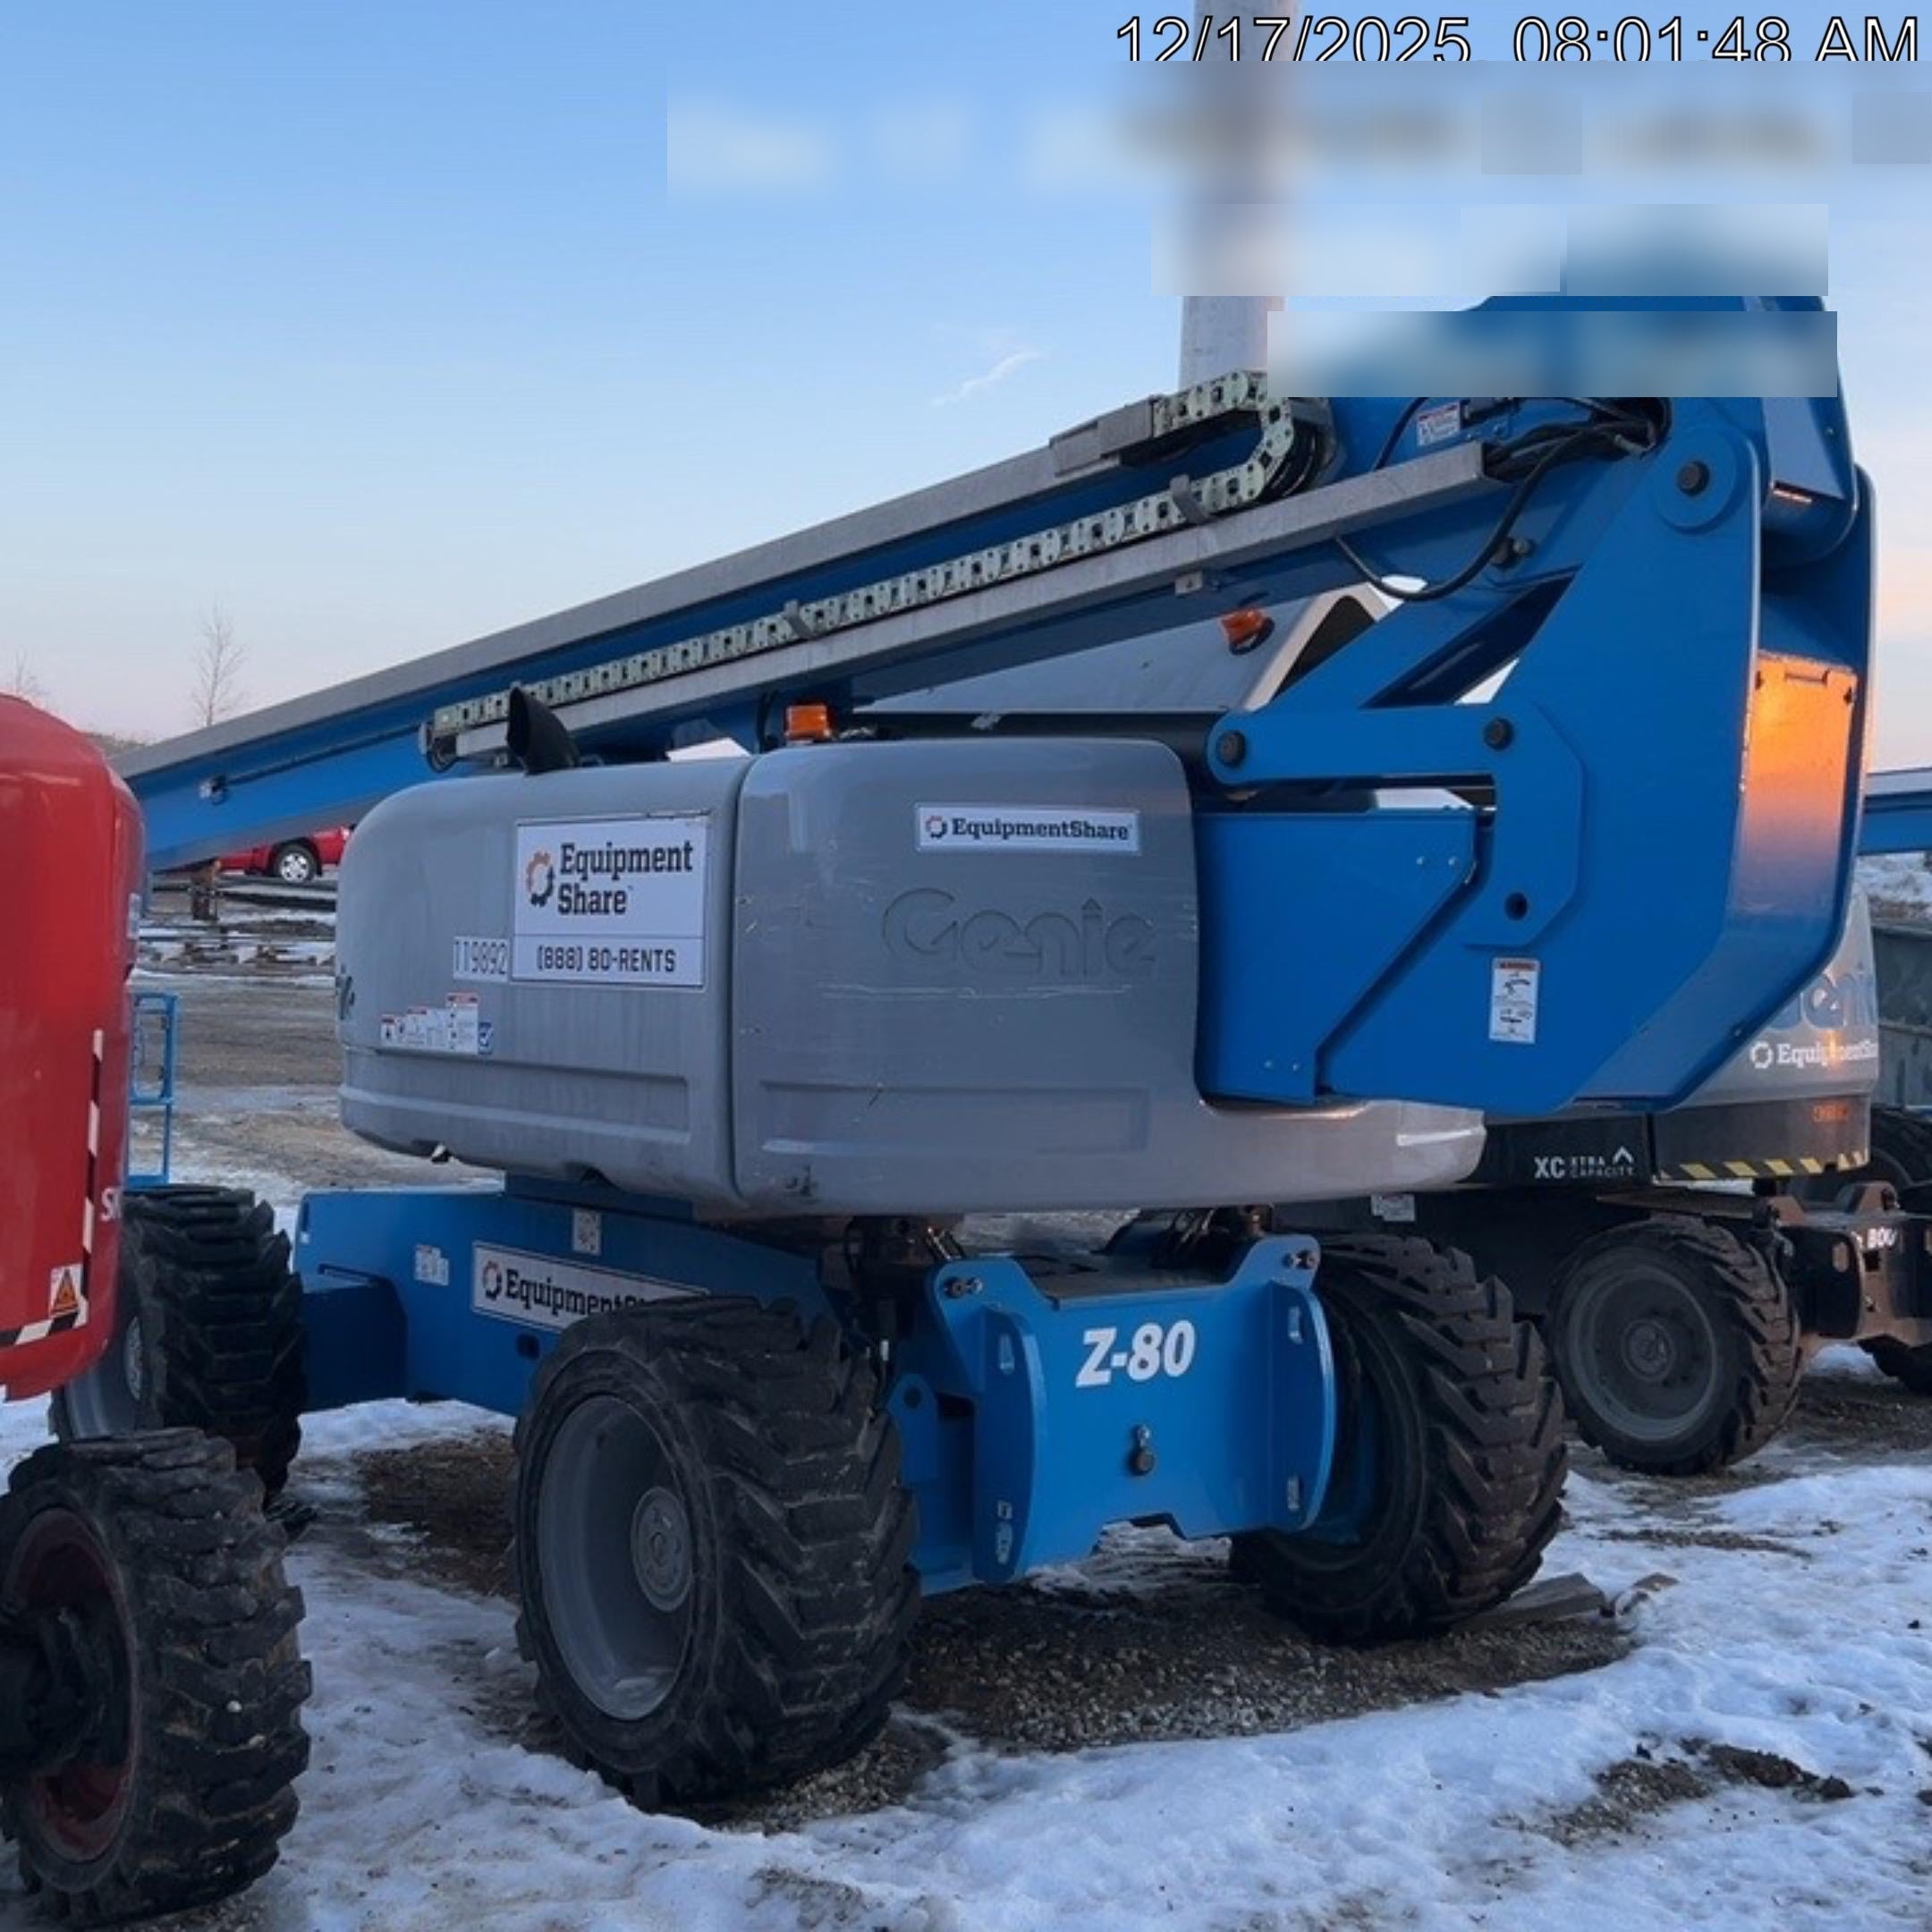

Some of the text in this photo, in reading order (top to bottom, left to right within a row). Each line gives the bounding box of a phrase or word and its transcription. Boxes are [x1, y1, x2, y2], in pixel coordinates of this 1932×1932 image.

[952, 817, 1129, 840] EquipmentShare
[560, 841, 693, 881] Equipment
[557, 883, 626, 915] Share
[882, 887, 1160, 979] Genie
[538, 944, 676, 972] (888) 80-RENTS
[1534, 1156, 1565, 1179] XC
[1075, 1318, 1196, 1388] Z-80
